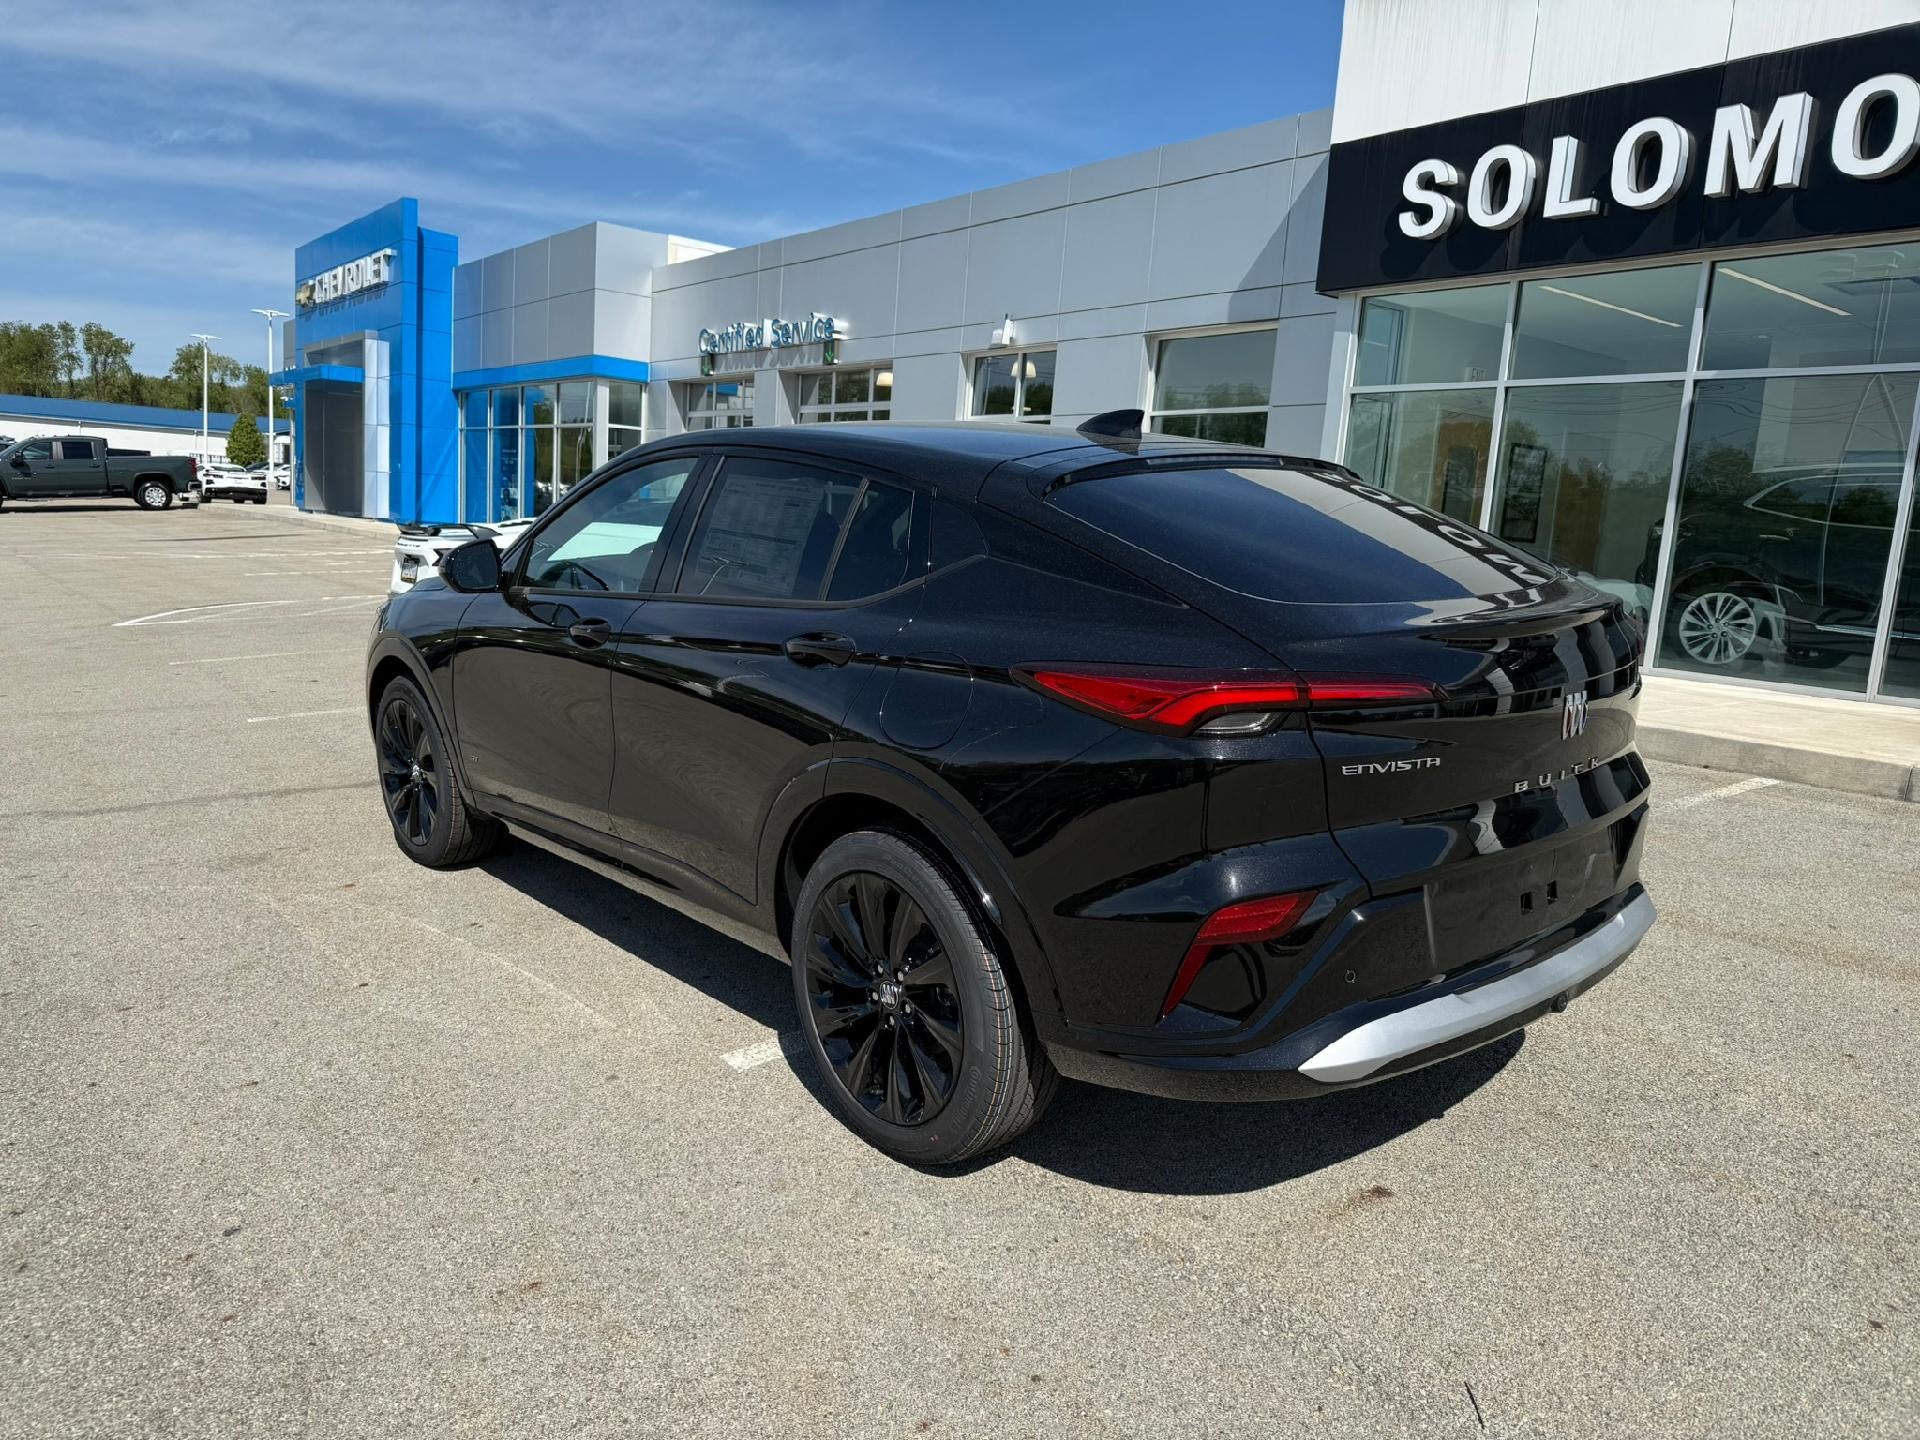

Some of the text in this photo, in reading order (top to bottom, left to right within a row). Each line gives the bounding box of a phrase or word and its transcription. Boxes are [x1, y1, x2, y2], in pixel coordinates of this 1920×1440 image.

[1399, 73, 1920, 240] SOLOMO
[314, 248, 396, 303] CHEVROLET
[699, 312, 835, 354] Certified Service
[1342, 757, 1441, 775] ENVISTA
[1514, 756, 1600, 793] BUICK
